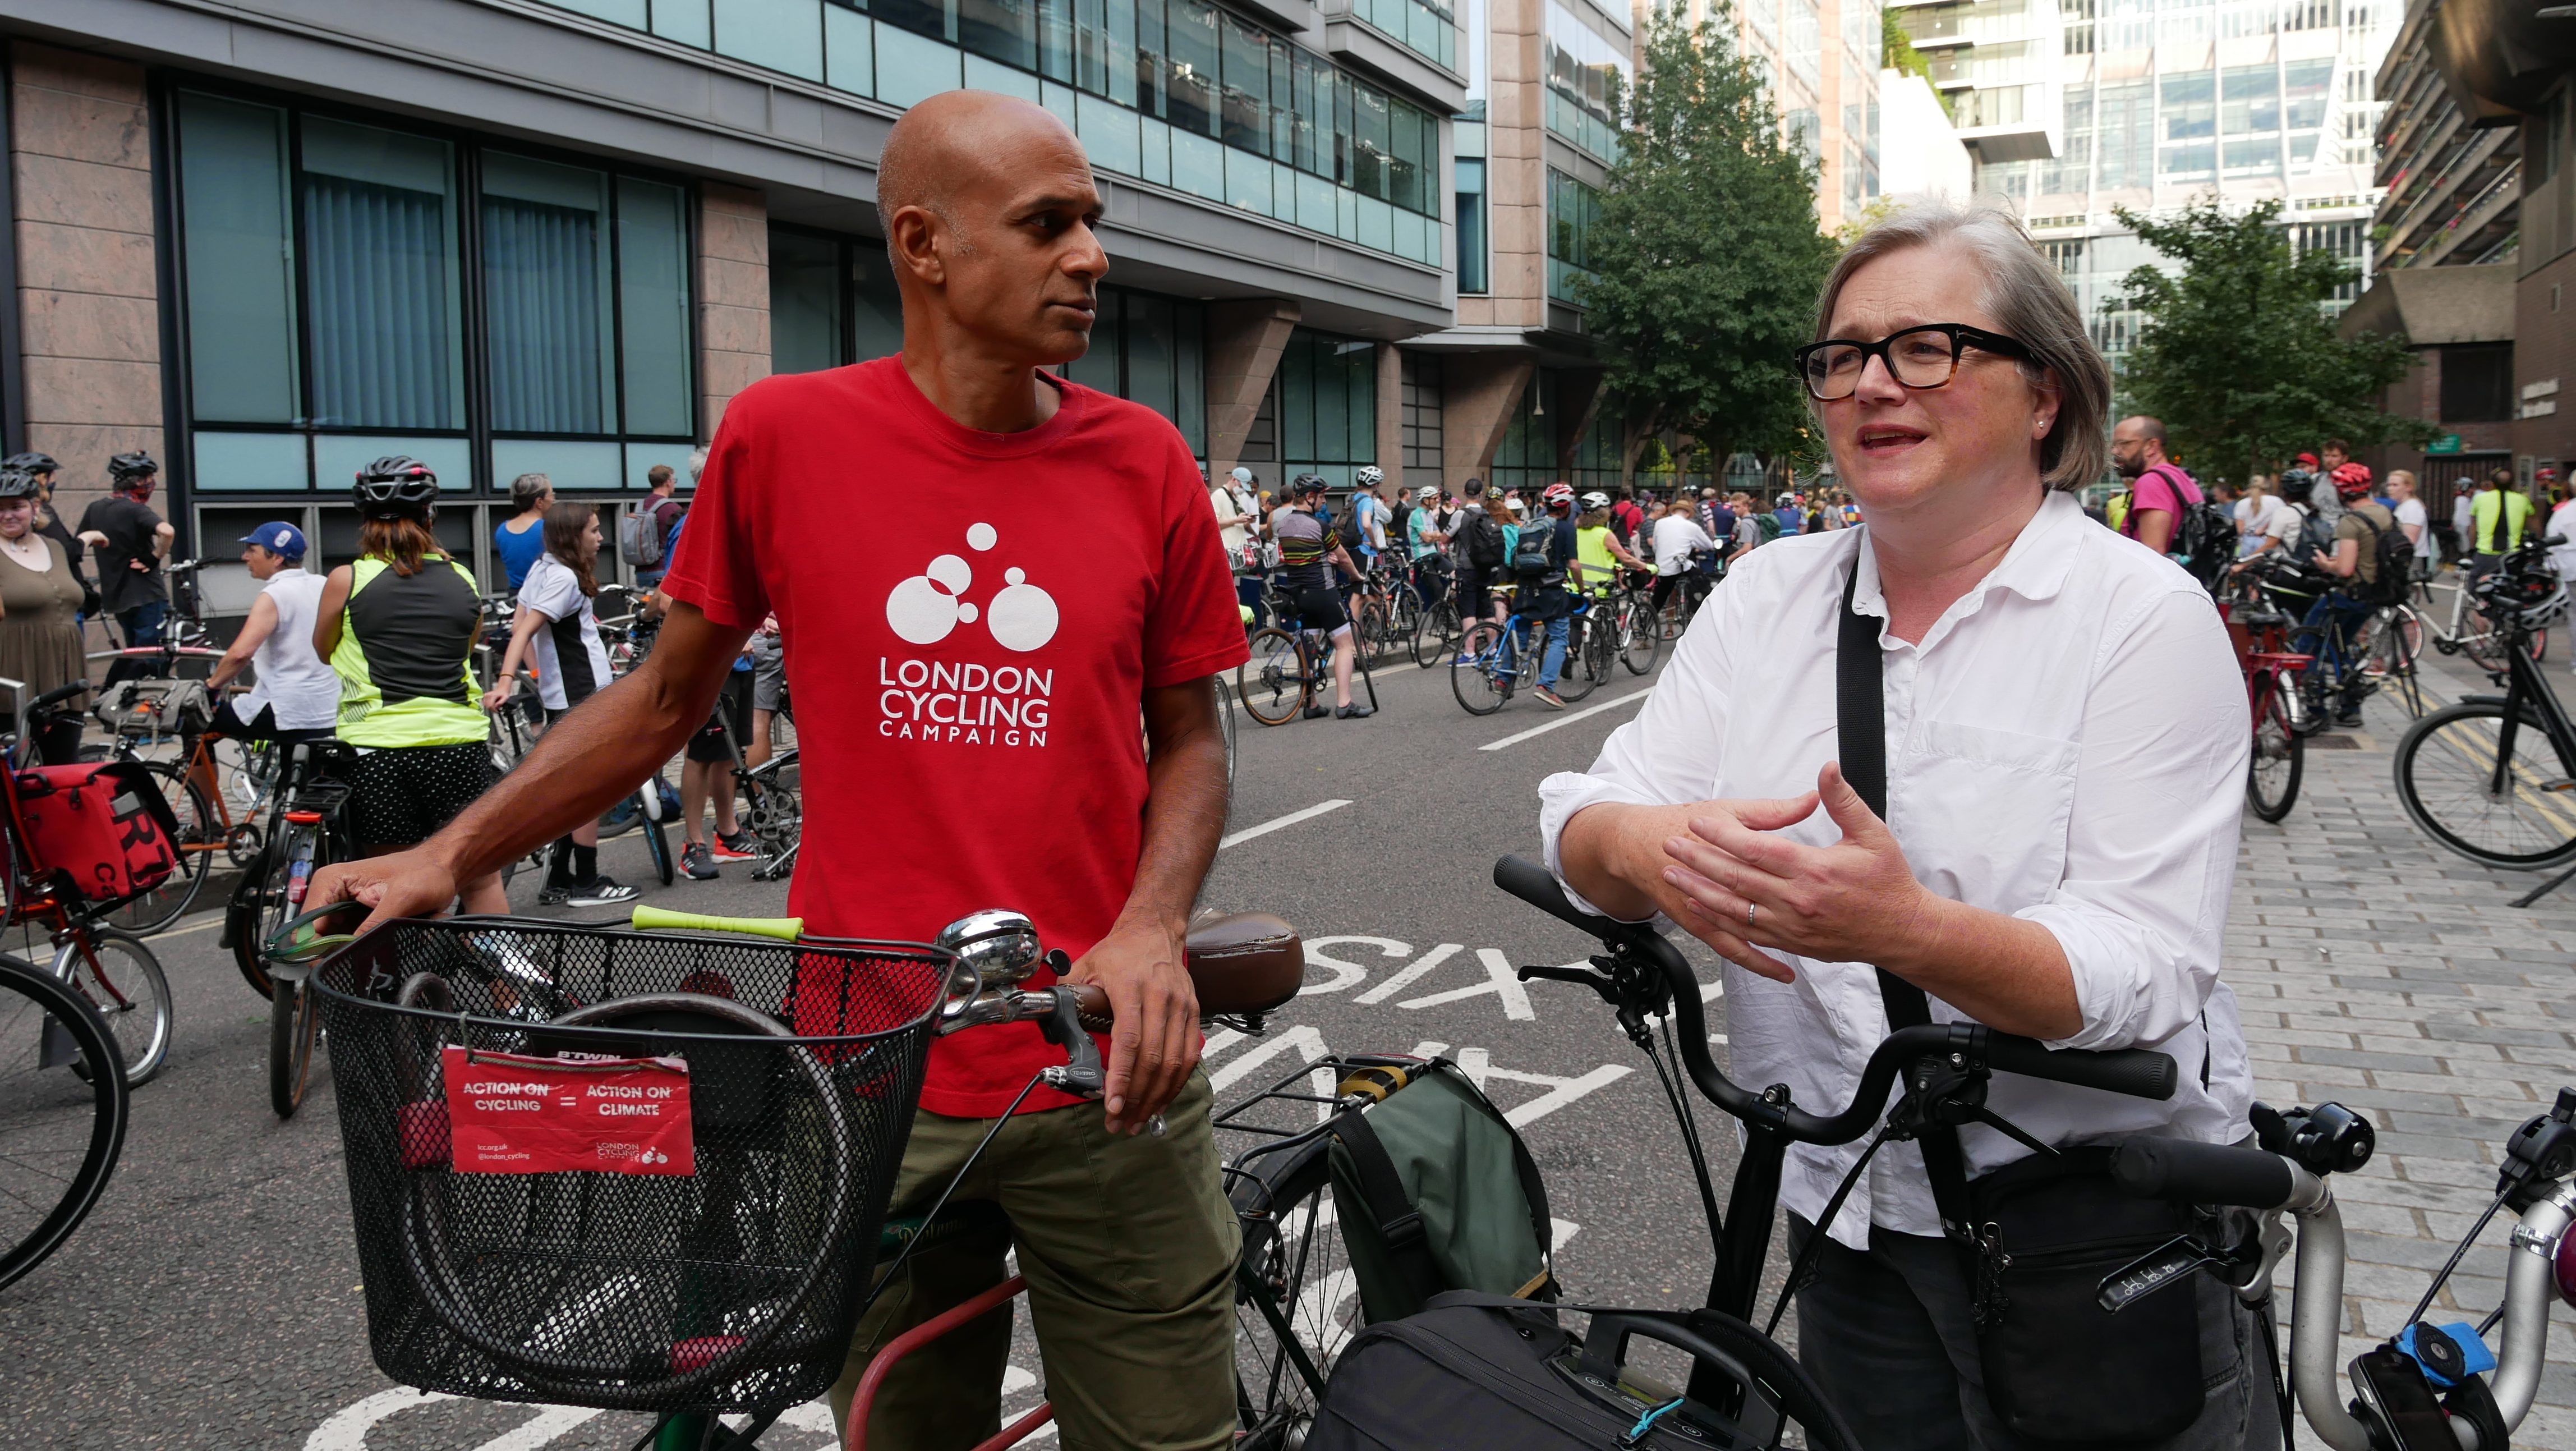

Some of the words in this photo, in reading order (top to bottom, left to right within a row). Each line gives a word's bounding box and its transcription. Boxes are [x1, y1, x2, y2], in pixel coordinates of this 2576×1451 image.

[880, 657, 1053, 696] LONDON
[880, 690, 1049, 728] CYCLING
[879, 720, 1047, 747] CAMPAIGN
[463, 1082, 520, 1095] ACTION
[524, 1083, 549, 1096] ON
[586, 1085, 643, 1098] ACTION
[647, 1086, 671, 1098] ON
[475, 1099, 541, 1111] CYCLING
[599, 1103, 660, 1115] CLIMATE
[596, 1142, 640, 1150] LONDON
[597, 1148, 640, 1156] CYCLING
[478, 1151, 530, 1160] @london_cycling
